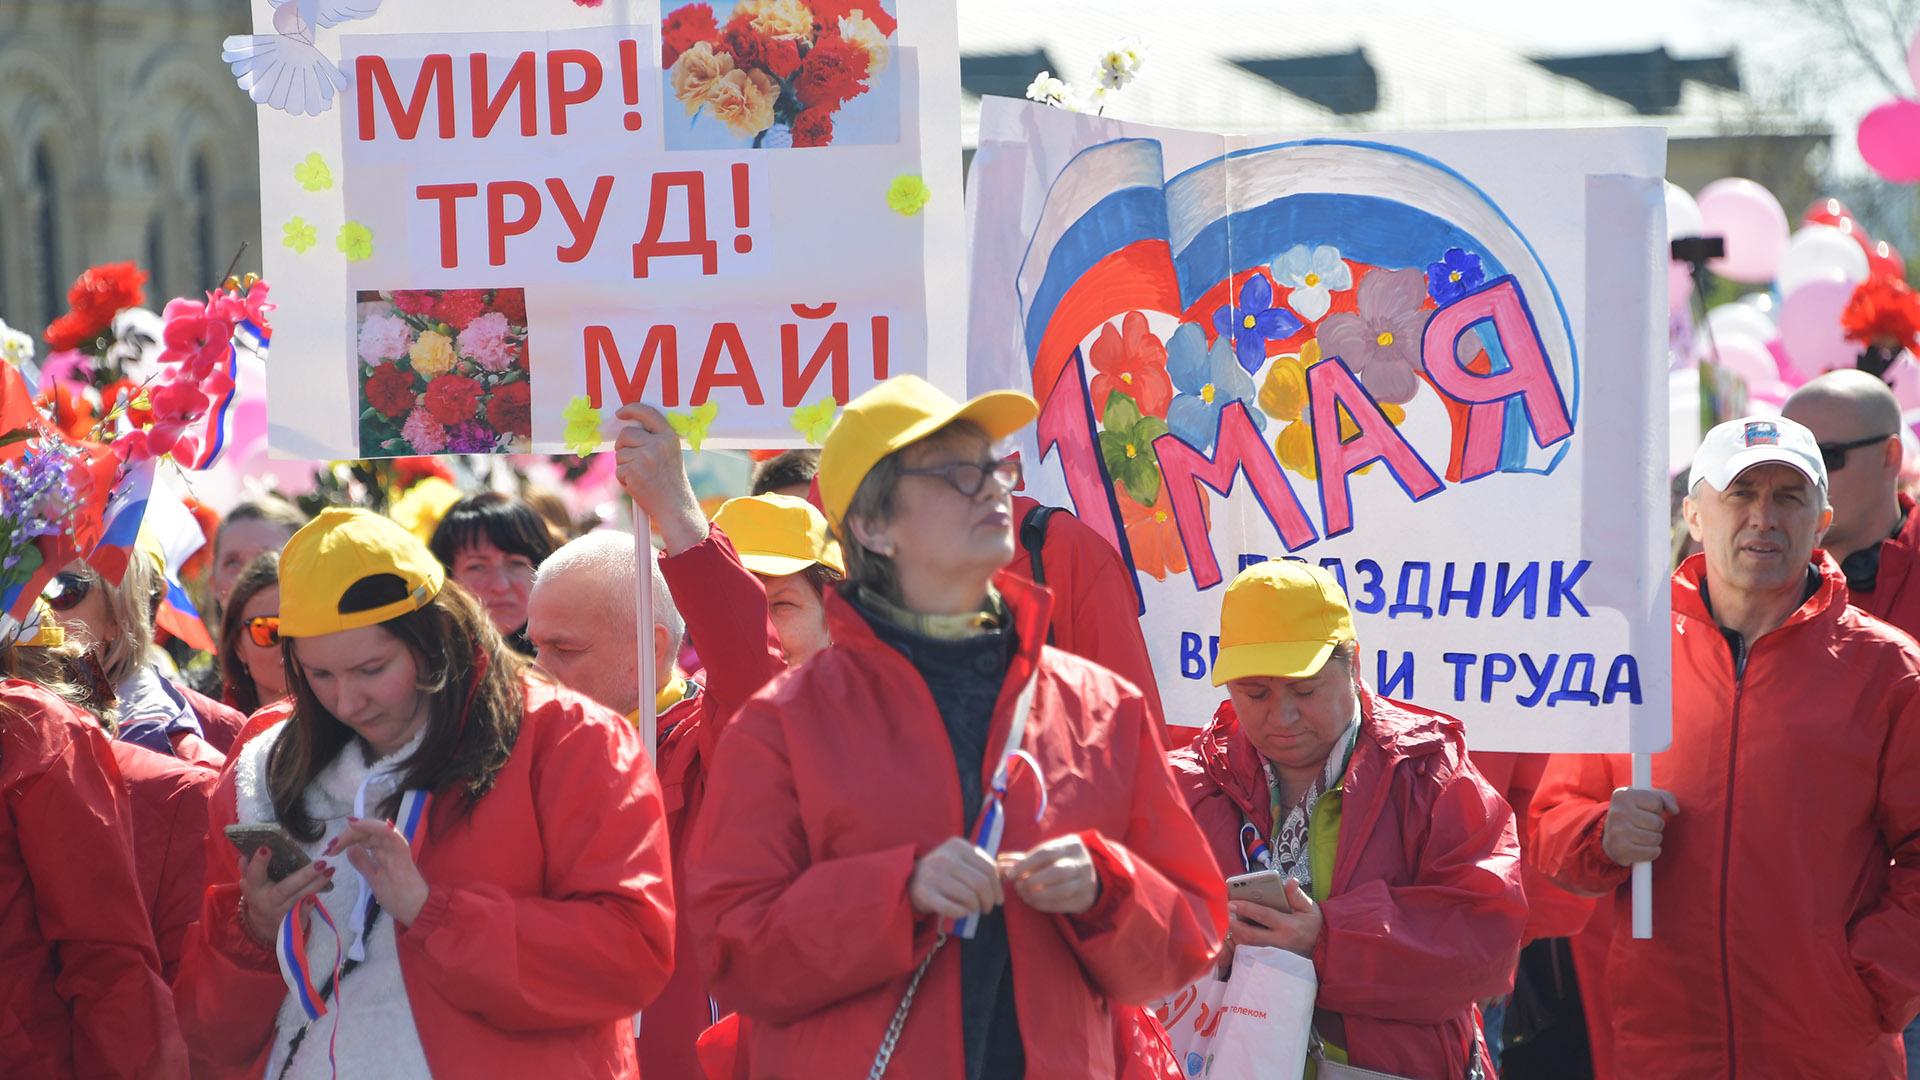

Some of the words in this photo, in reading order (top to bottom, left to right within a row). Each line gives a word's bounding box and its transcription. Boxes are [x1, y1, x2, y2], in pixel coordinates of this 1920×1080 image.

[355, 39, 645, 141] МИР!
[416, 163, 752, 279] ТРУД!
[583, 302, 889, 410] МАЙ!
[1037, 345, 1146, 616] 1
[1151, 273, 1575, 592] МАЯ
[1238, 553, 1593, 620] АЗДНИК
[1377, 649, 1415, 700] И
[1443, 652, 1643, 708] ТРУДА
